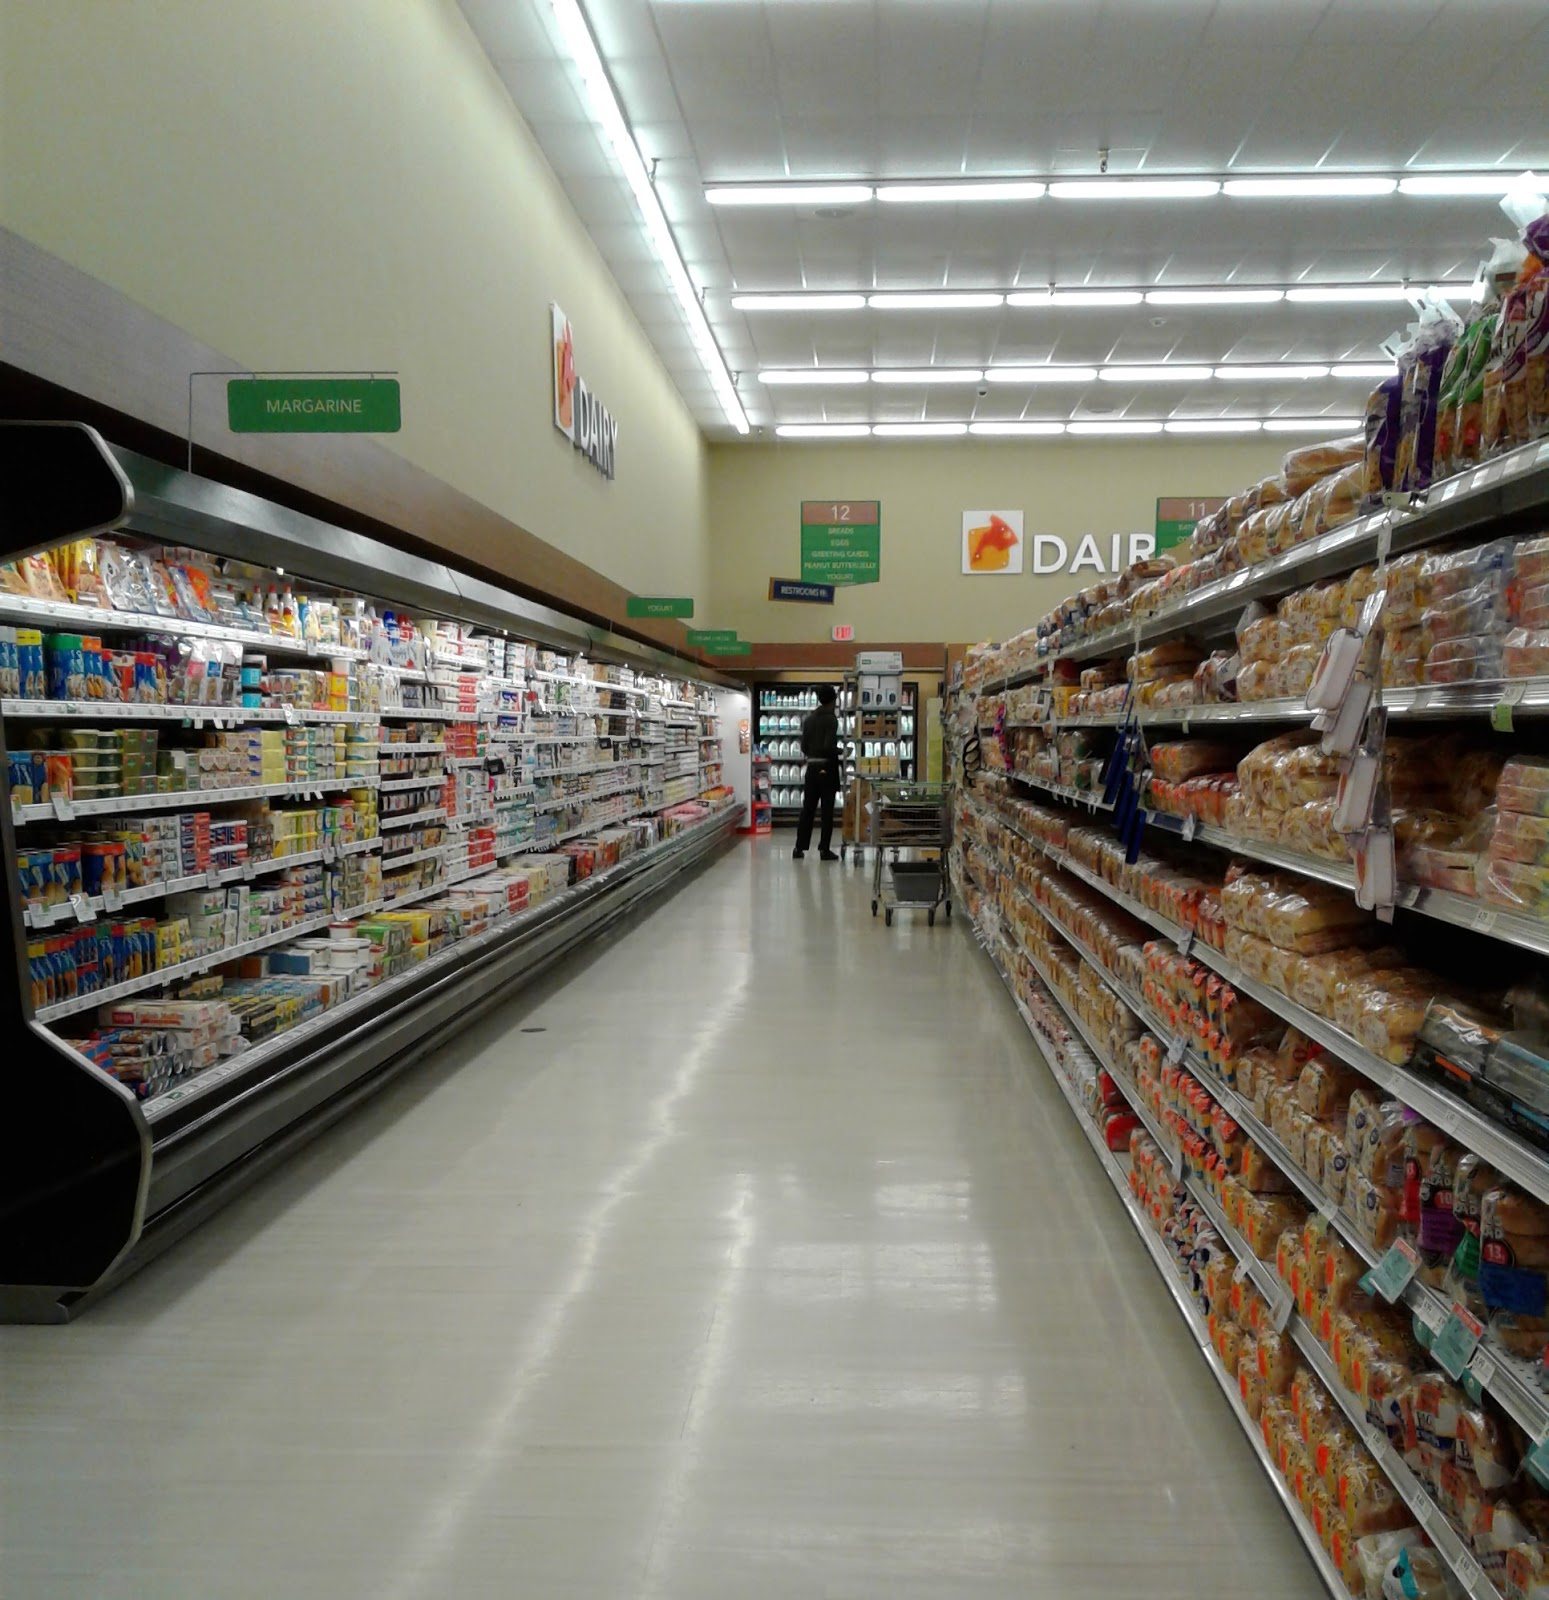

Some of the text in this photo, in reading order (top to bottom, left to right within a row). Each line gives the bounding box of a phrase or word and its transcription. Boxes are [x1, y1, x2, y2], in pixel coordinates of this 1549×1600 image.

[265, 399, 363, 413] MARGARINE
[576, 376, 618, 477] DAIRY
[831, 504, 850, 520] 12
[1188, 502, 1206, 517] 11
[827, 527, 855, 535] BREADS
[811, 550, 846, 558] GREETING
[1032, 533, 1156, 574] DAIR
[804, 561, 830, 569] PEANUT
[780, 585, 819, 597] RESTROOMS
[647, 604, 673, 613] YOGURT
